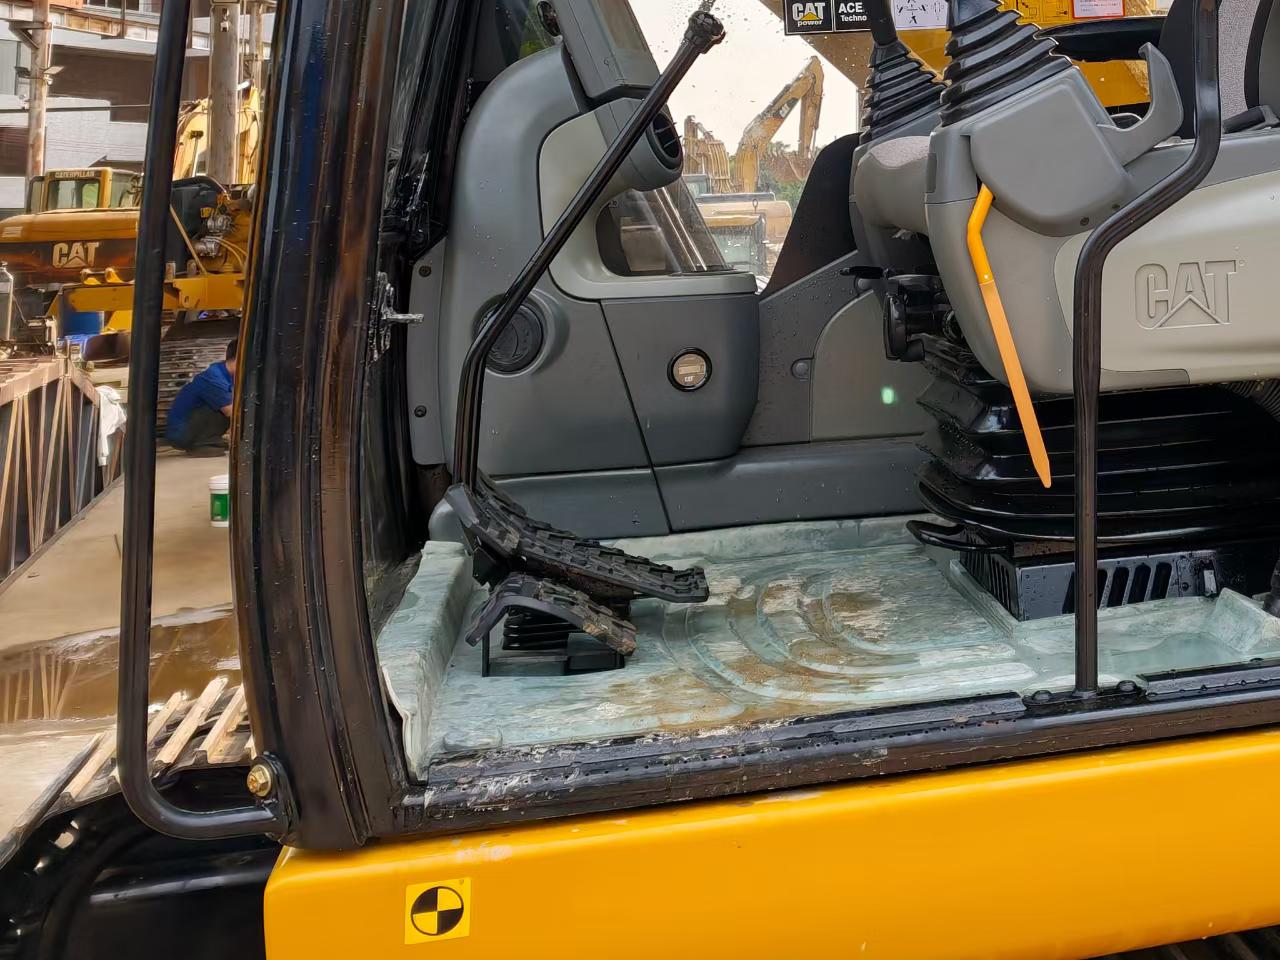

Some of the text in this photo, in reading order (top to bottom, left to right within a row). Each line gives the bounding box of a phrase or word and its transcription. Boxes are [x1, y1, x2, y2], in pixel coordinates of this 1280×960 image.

[792, 2, 826, 21] CAT
[838, 2, 865, 13] ACE
[52, 242, 99, 268] CAT
[1135, 260, 1236, 329] CAT
